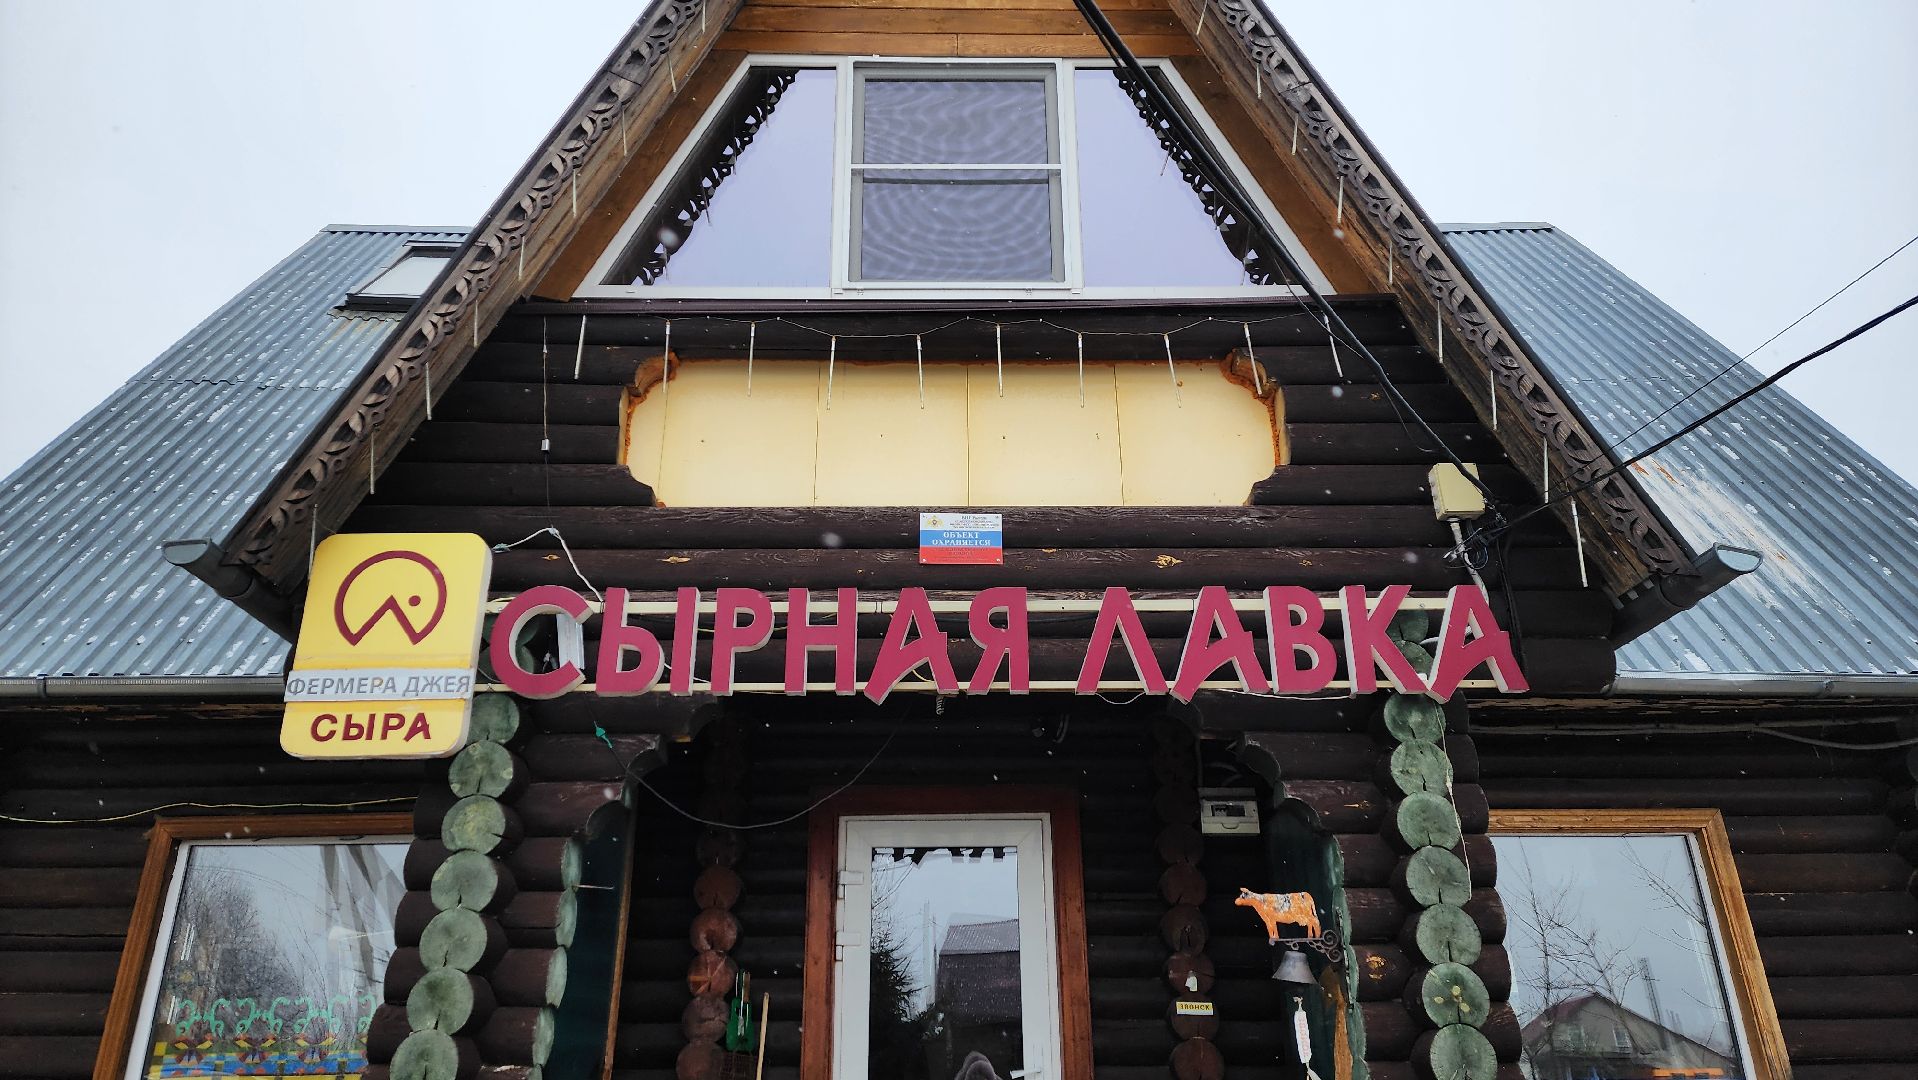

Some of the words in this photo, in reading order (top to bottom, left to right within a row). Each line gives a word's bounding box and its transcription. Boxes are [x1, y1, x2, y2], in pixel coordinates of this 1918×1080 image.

[932, 538, 991, 546] ОХРАНЯЕТСЯ
[489, 584, 1030, 705] СЫРНАЯ
[1075, 584, 1531, 704] ЛАВКА
[287, 676, 397, 696] ФЕРМЕРА
[403, 675, 471, 697] ДЖЕЯ
[310, 712, 432, 742] СЫРА
